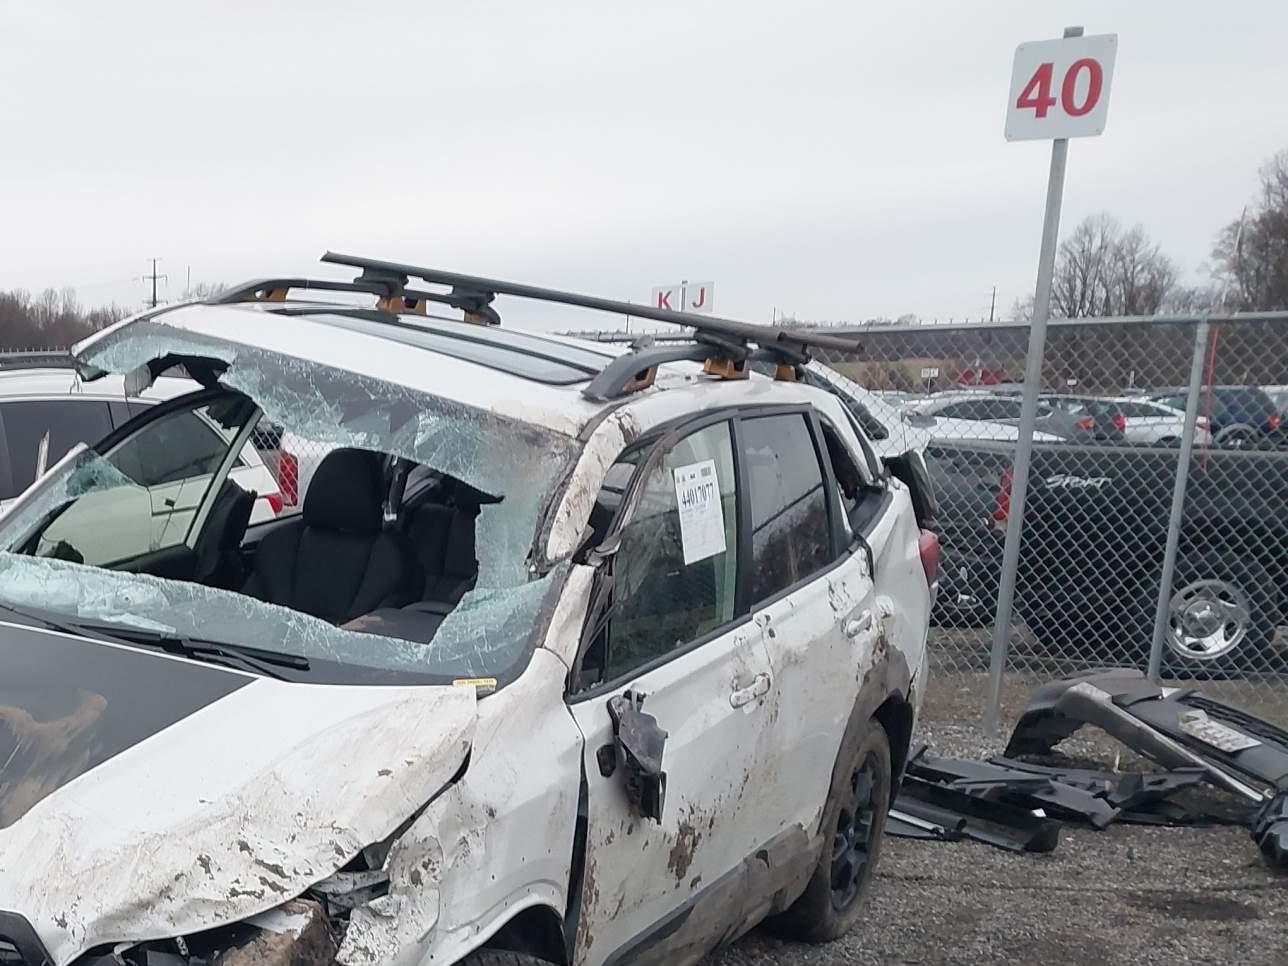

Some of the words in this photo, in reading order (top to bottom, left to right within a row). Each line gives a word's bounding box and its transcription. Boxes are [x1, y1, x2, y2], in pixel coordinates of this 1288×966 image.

[1016, 57, 1103, 119] 40
[658, 290, 673, 310] K
[692, 287, 705, 308] J
[681, 482, 714, 509] 44017077
